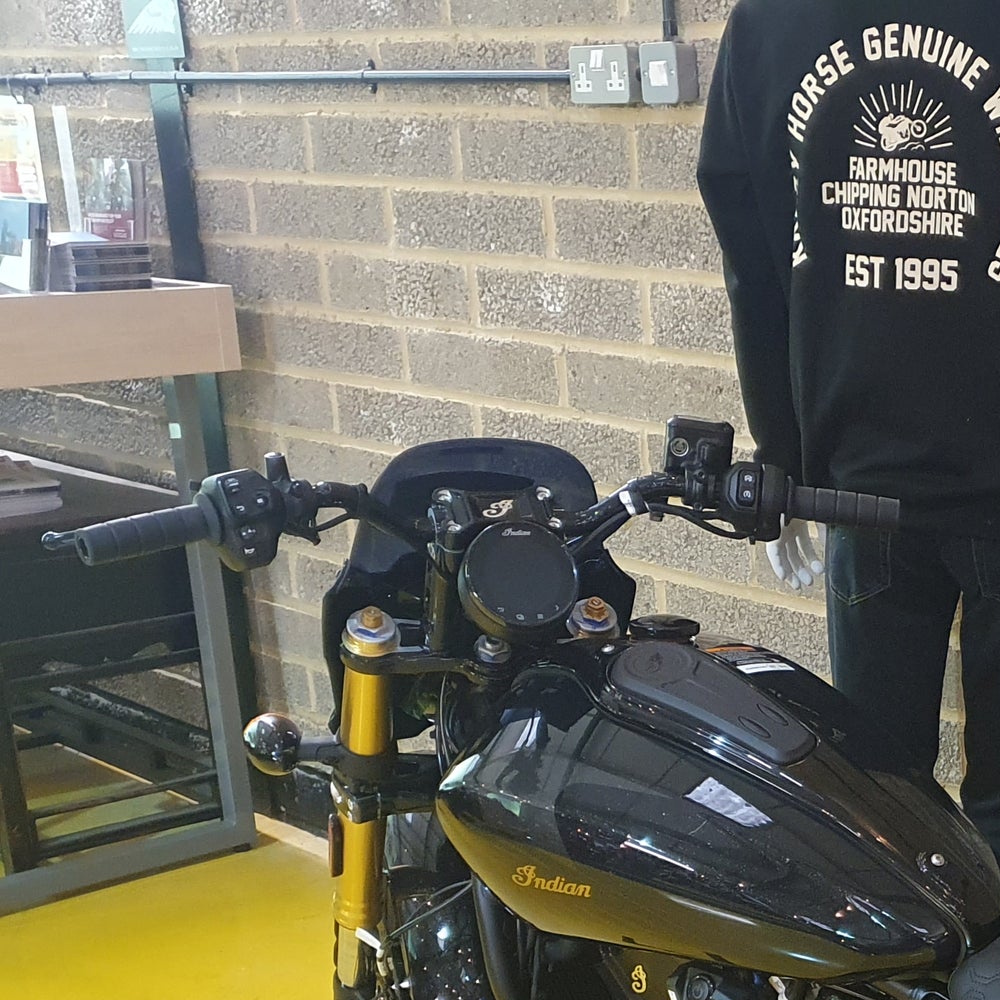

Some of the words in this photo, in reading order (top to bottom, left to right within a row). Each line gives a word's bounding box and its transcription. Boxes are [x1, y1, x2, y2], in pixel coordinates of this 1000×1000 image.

[787, 39, 855, 142] HORSE
[862, 22, 990, 91] GENUINE
[849, 156, 957, 187] FARMHOUSE
[821, 181, 901, 208] CHIPPING
[906, 184, 976, 217] NORTON
[841, 206, 964, 238] OXFORDSHIRE
[845, 253, 886, 289] EST
[894, 257, 959, 292] 1995
[511, 864, 592, 898] Indian
